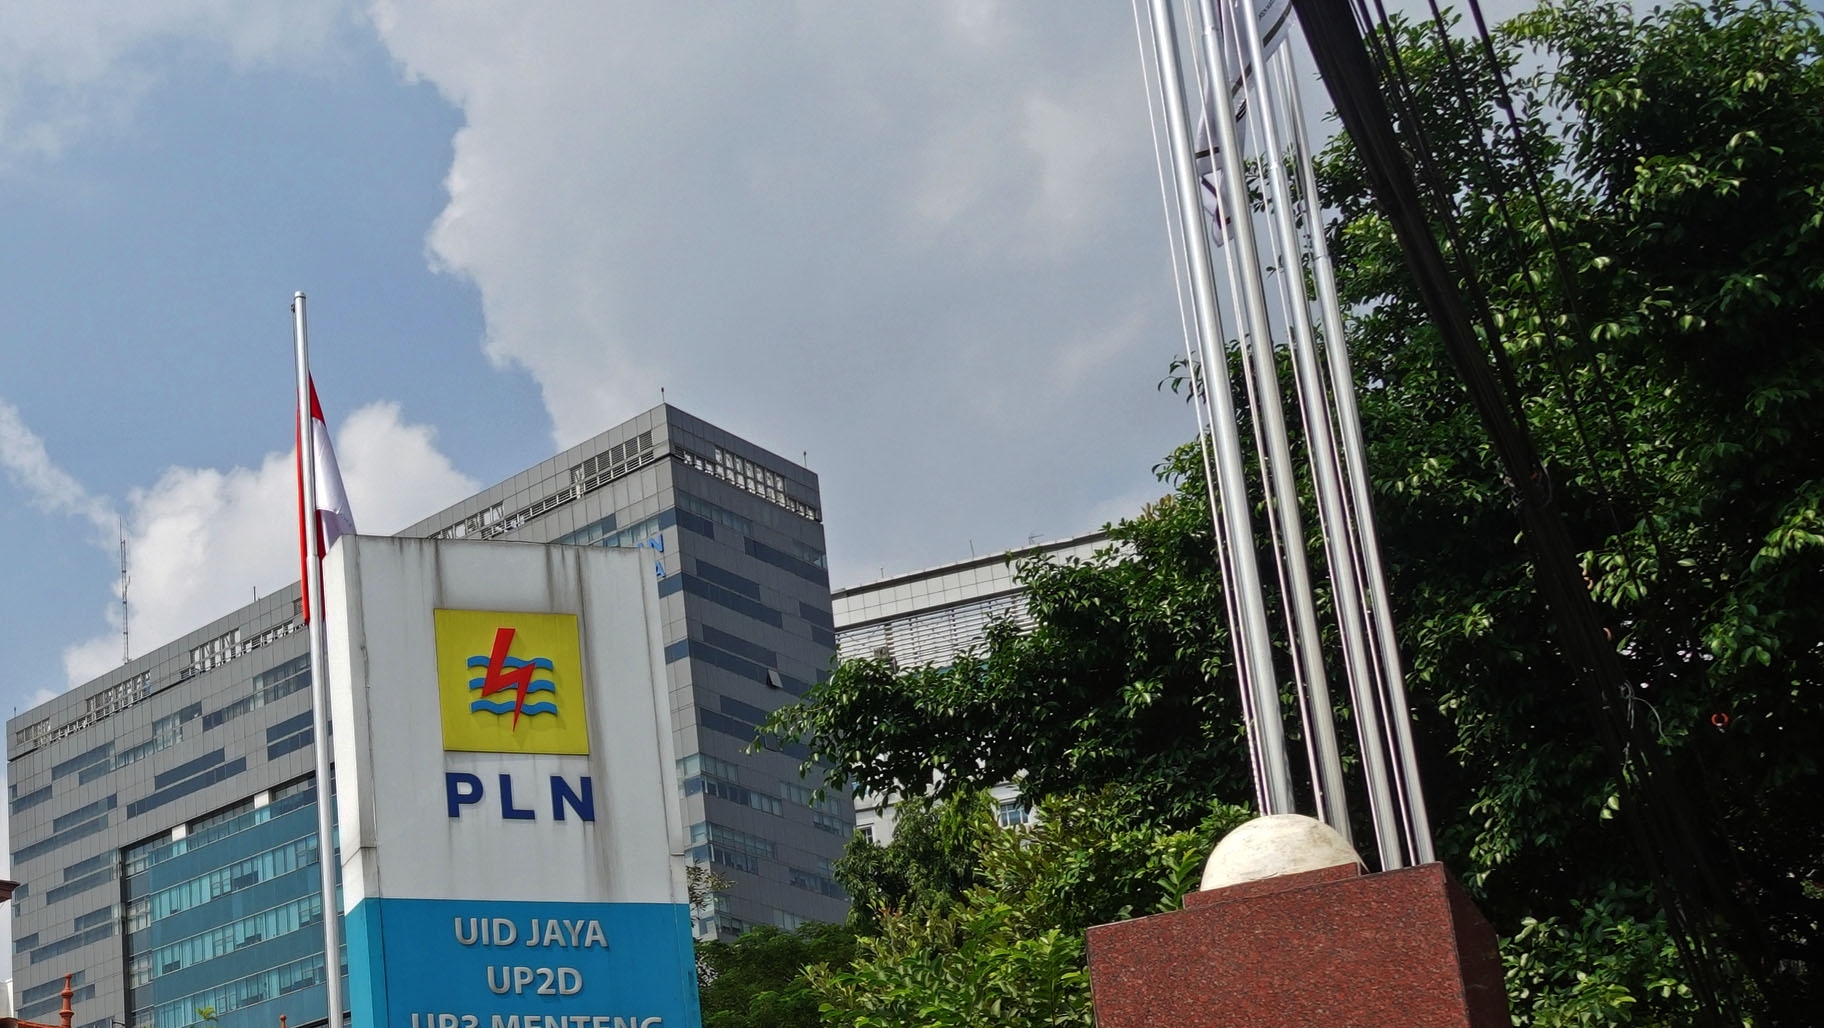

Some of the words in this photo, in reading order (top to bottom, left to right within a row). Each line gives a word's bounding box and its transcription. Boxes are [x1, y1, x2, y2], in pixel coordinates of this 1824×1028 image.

[444, 771, 596, 822] PLN
[454, 917, 519, 946] UID
[526, 918, 609, 948] JAYA
[486, 965, 584, 996] UP2D
